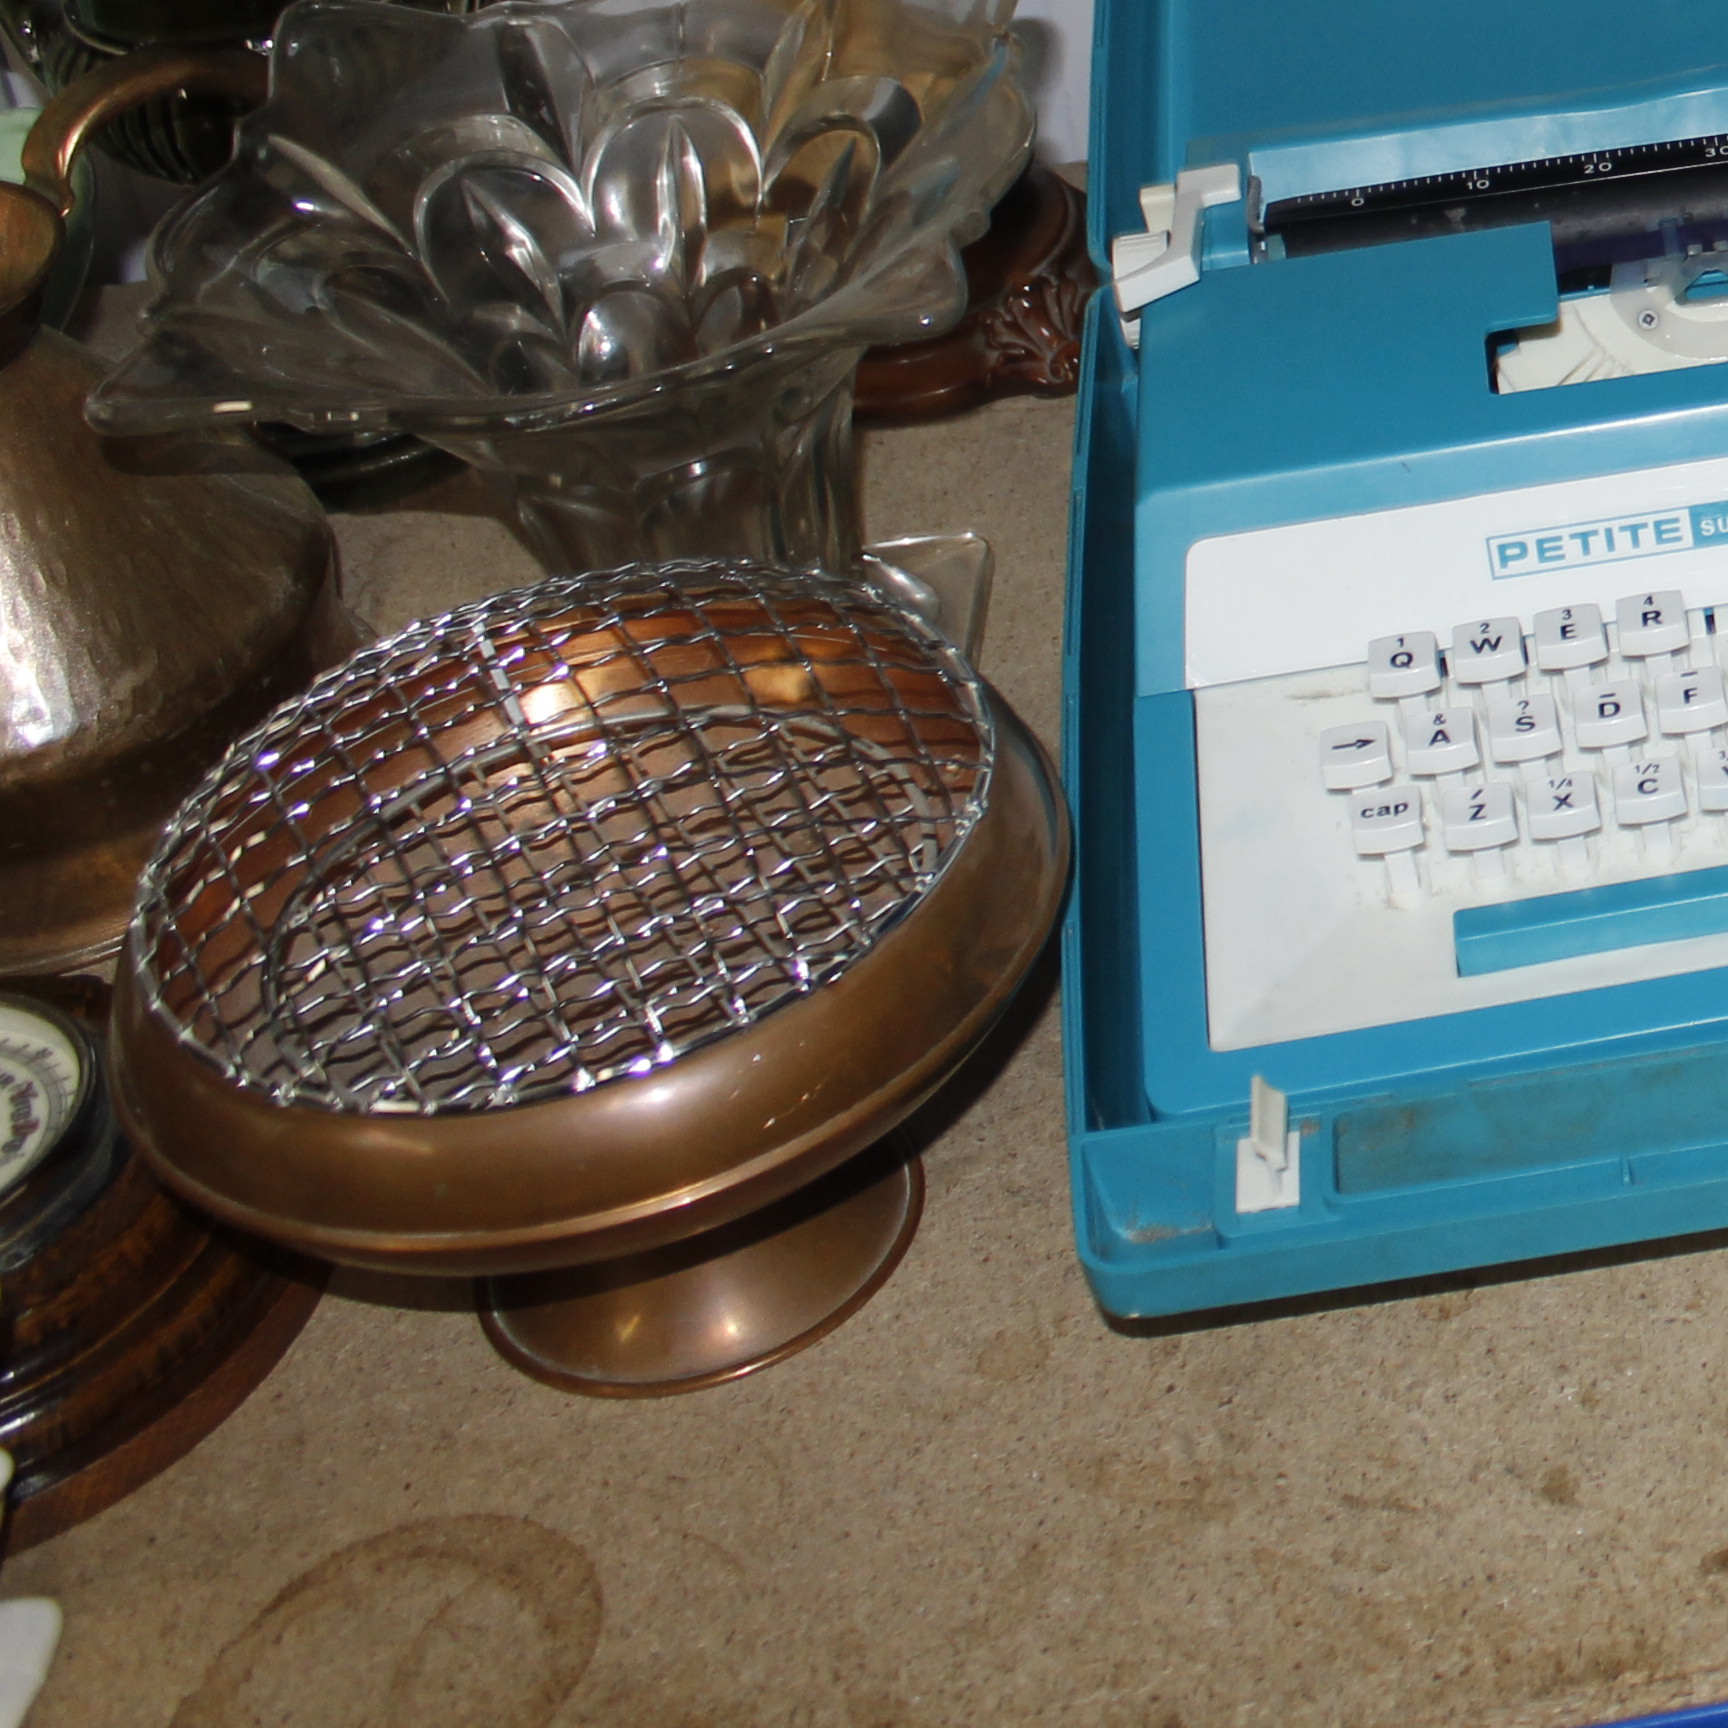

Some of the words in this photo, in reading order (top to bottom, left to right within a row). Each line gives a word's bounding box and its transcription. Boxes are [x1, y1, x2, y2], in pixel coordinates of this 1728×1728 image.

[1584, 161, 1612, 174] 20
[1467, 178, 1490, 190] 10
[1497, 517, 1683, 569] PETITE
[1643, 595, 1654, 606] 4
[1562, 610, 1572, 620] 3
[1641, 610, 1661, 626] R
[1480, 623, 1490, 634] 2
[1561, 624, 1576, 640] E
[1397, 638, 1404, 648] 1
[1470, 636, 1502, 654] W
[1389, 651, 1414, 668] Q
[1683, 687, 1698, 704] F
[1518, 700, 1529, 715] ?
[1598, 701, 1621, 719] D
[1433, 713, 1446, 725] &
[1515, 716, 1536, 732] S
[1428, 730, 1450, 746] A
[1637, 778, 1659, 794] C
[1553, 794, 1574, 810] X
[1361, 801, 1409, 820] cap
[1469, 804, 1486, 821] Z
